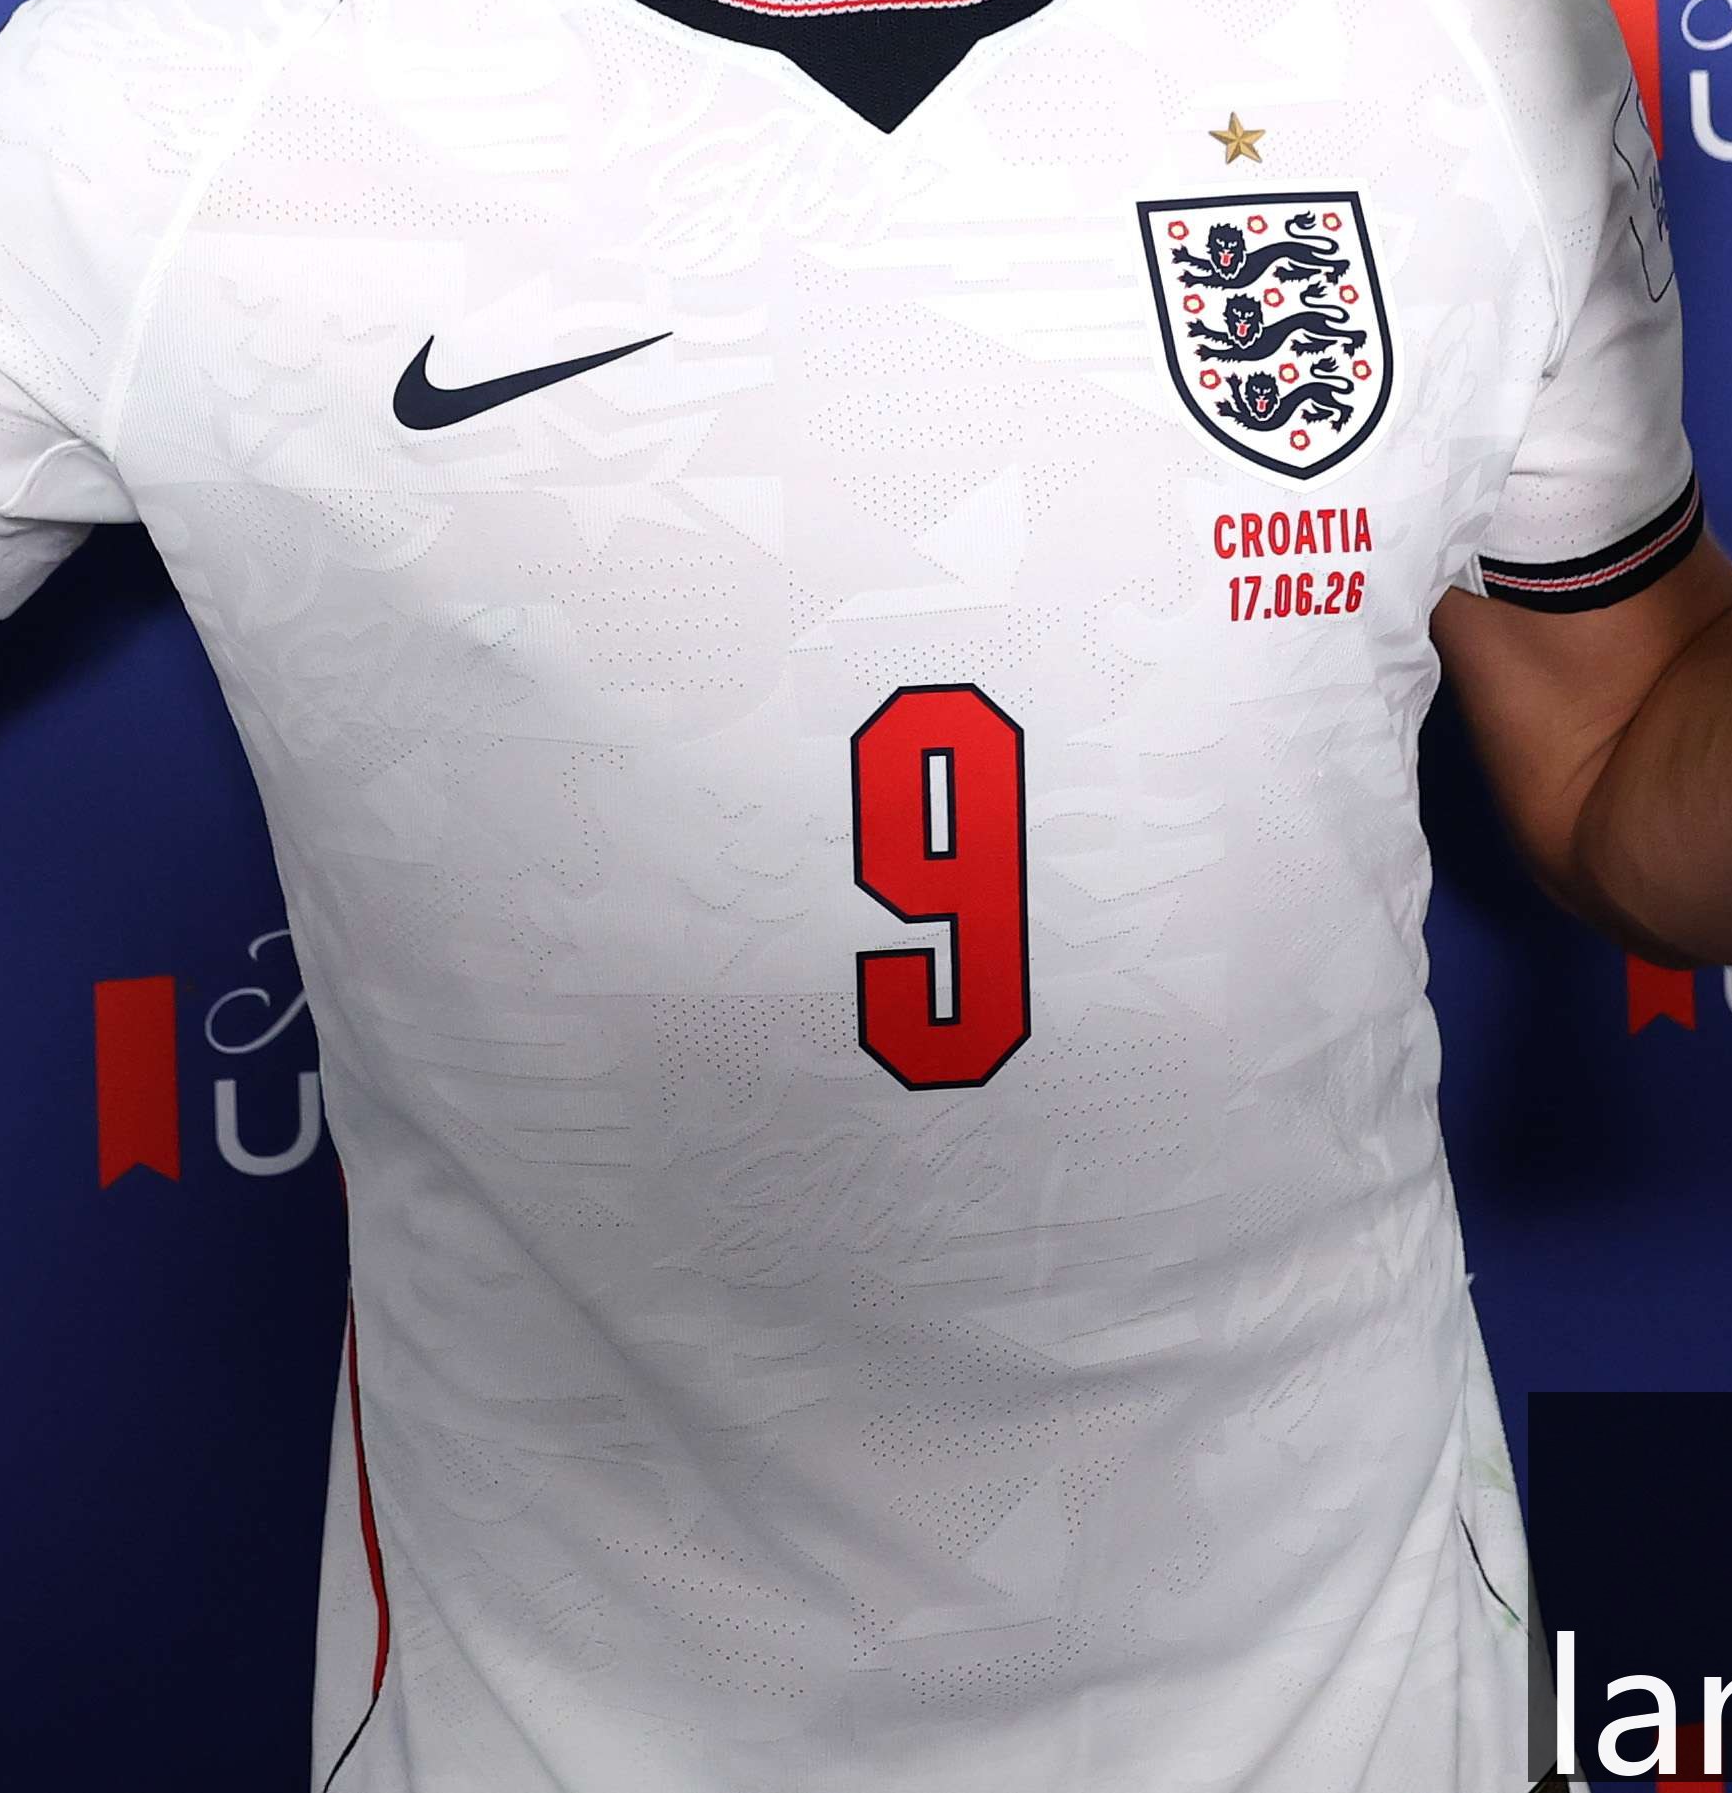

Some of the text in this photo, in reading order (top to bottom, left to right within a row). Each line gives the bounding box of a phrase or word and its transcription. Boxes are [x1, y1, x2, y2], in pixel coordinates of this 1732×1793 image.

[1212, 507, 1373, 559] CROATIA
[1227, 571, 1365, 622] 17.06.26
[850, 683, 1031, 1092] 9
